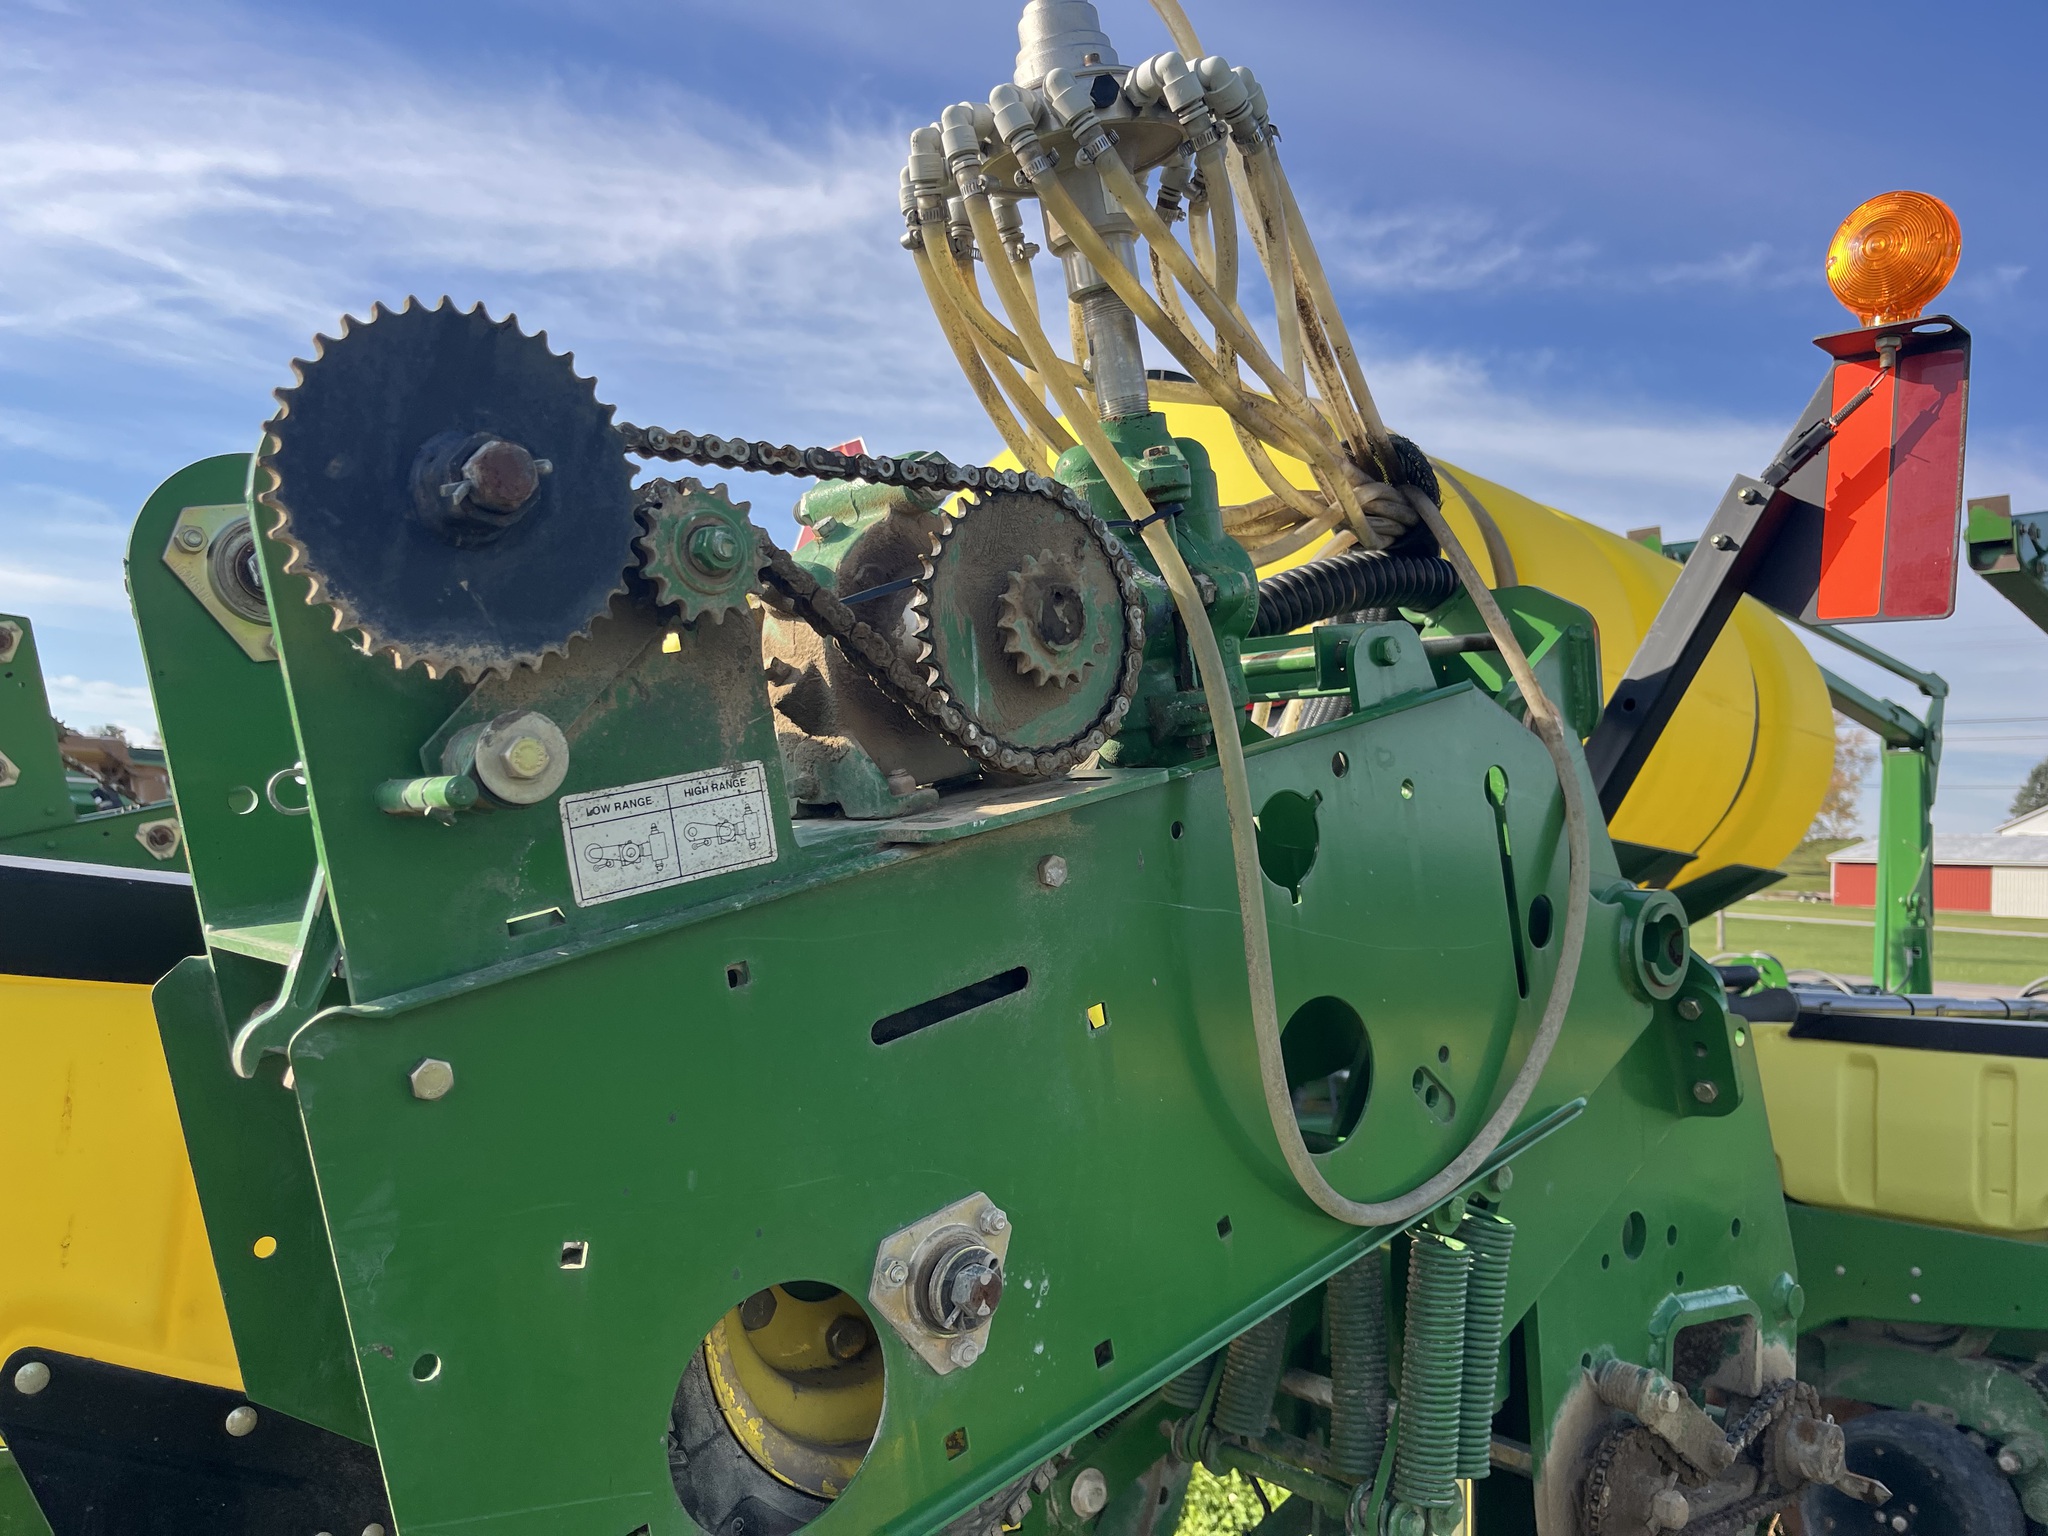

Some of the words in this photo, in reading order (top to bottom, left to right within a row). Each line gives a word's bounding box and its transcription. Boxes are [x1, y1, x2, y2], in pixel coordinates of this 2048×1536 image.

[684, 785, 709, 798] HIGH
[711, 777, 747, 792] RANGE
[586, 804, 611, 817] LOW
[614, 796, 653, 812] RANGE
